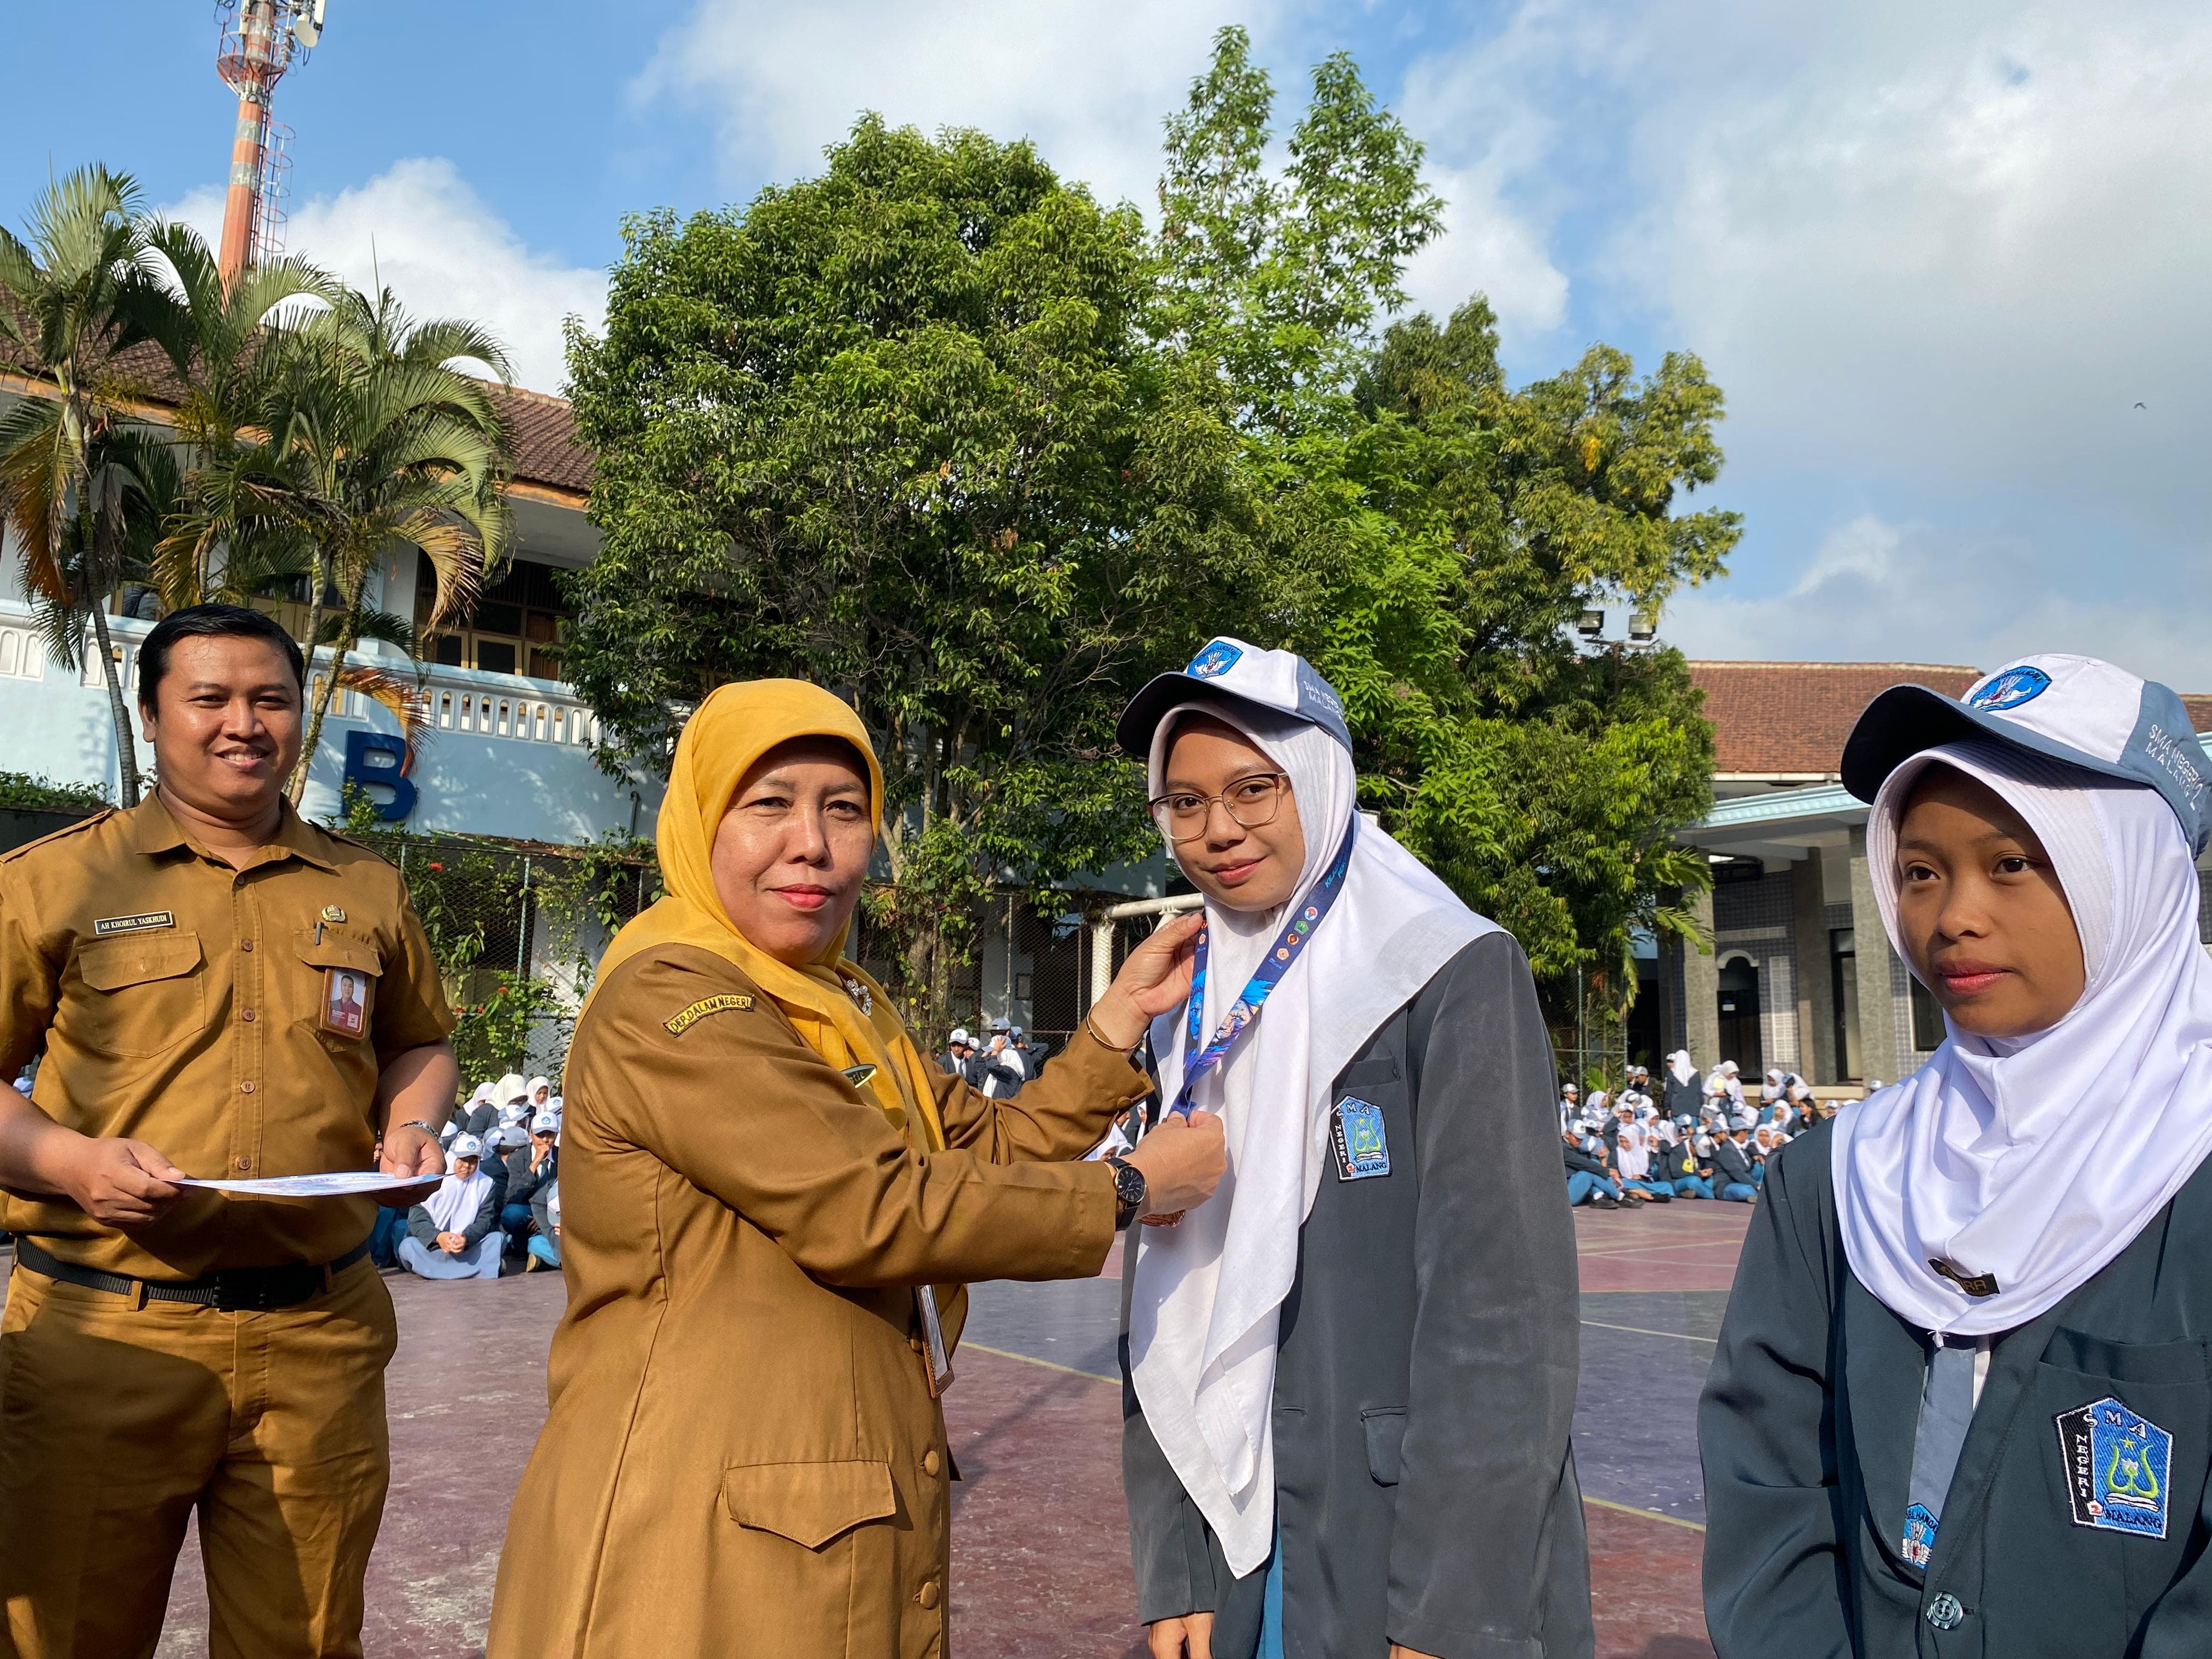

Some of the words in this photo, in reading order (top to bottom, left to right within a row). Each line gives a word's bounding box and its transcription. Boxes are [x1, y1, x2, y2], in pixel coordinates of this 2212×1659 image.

[2149, 724, 2172, 755] SMA
[341, 730, 418, 821] B
[2146, 742, 2190, 797] MALANG
[101, 922, 110, 930] AH
[111, 918, 137, 928] KHOIRUL
[137, 915, 167, 924] YASKHUDI
[687, 998, 718, 1020] DALAM
[718, 996, 749, 1008] NEGERI
[1336, 1102, 1370, 1119] SMA
[1335, 1125, 1347, 1163] NEGERI
[1356, 1163, 1387, 1172] MALANG
[2083, 1409, 2147, 1440] SMA
[2075, 1434, 2090, 1498] NEGERI
[2091, 1504, 2102, 1514] 2
[2103, 1510, 2162, 1528] MALANG
